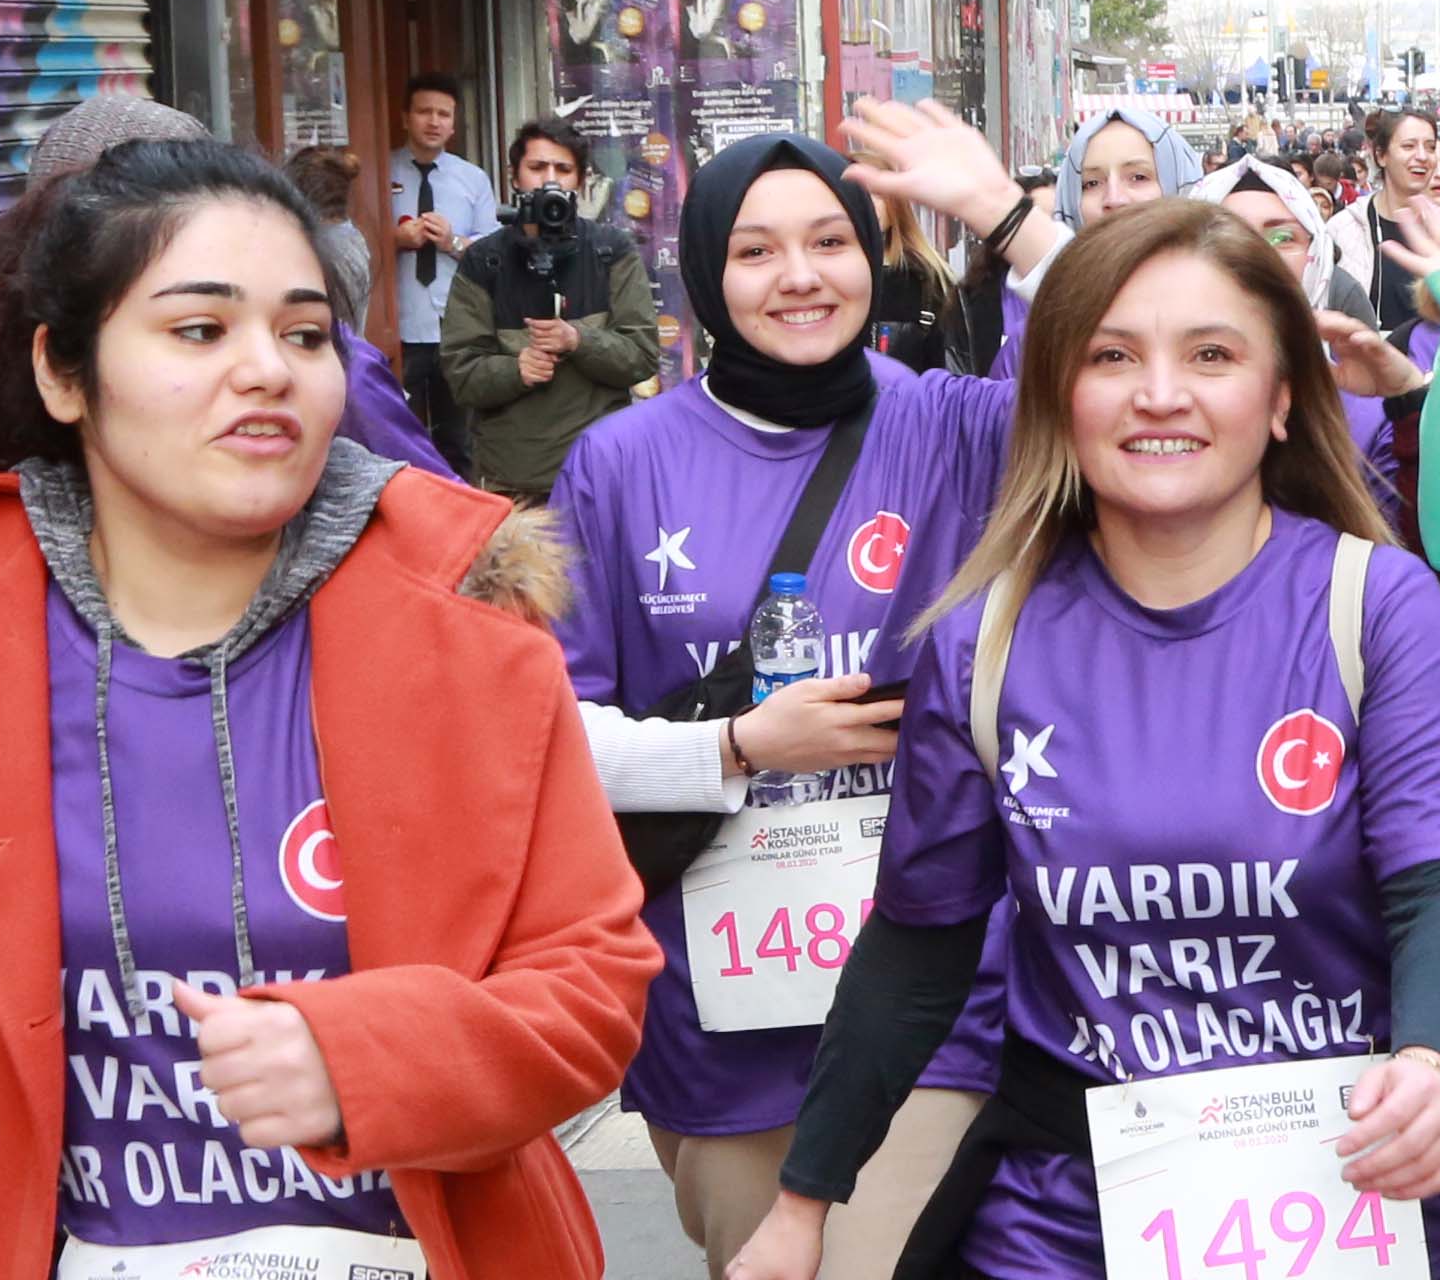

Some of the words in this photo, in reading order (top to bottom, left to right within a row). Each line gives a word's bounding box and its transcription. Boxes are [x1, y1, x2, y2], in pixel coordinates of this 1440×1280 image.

[767, 821, 840, 839] İSTANBULU
[750, 851, 792, 862] KADINLAR
[791, 847, 818, 859] GÜNÜ
[818, 845, 844, 857] ETABI
[1034, 858, 1300, 927] VARDIK
[710, 899, 876, 979] 148
[1074, 933, 1282, 1001] VARIZ
[1130, 979, 1373, 1073] OLACAĞIZ
[1224, 1088, 1314, 1110] İSTANBULU
[1198, 1125, 1255, 1141] KADINLAR
[1256, 1121, 1289, 1134] GÜNÜ
[1289, 1119, 1320, 1131] ETABI
[212, 1251, 321, 1272] İSTANBULU
